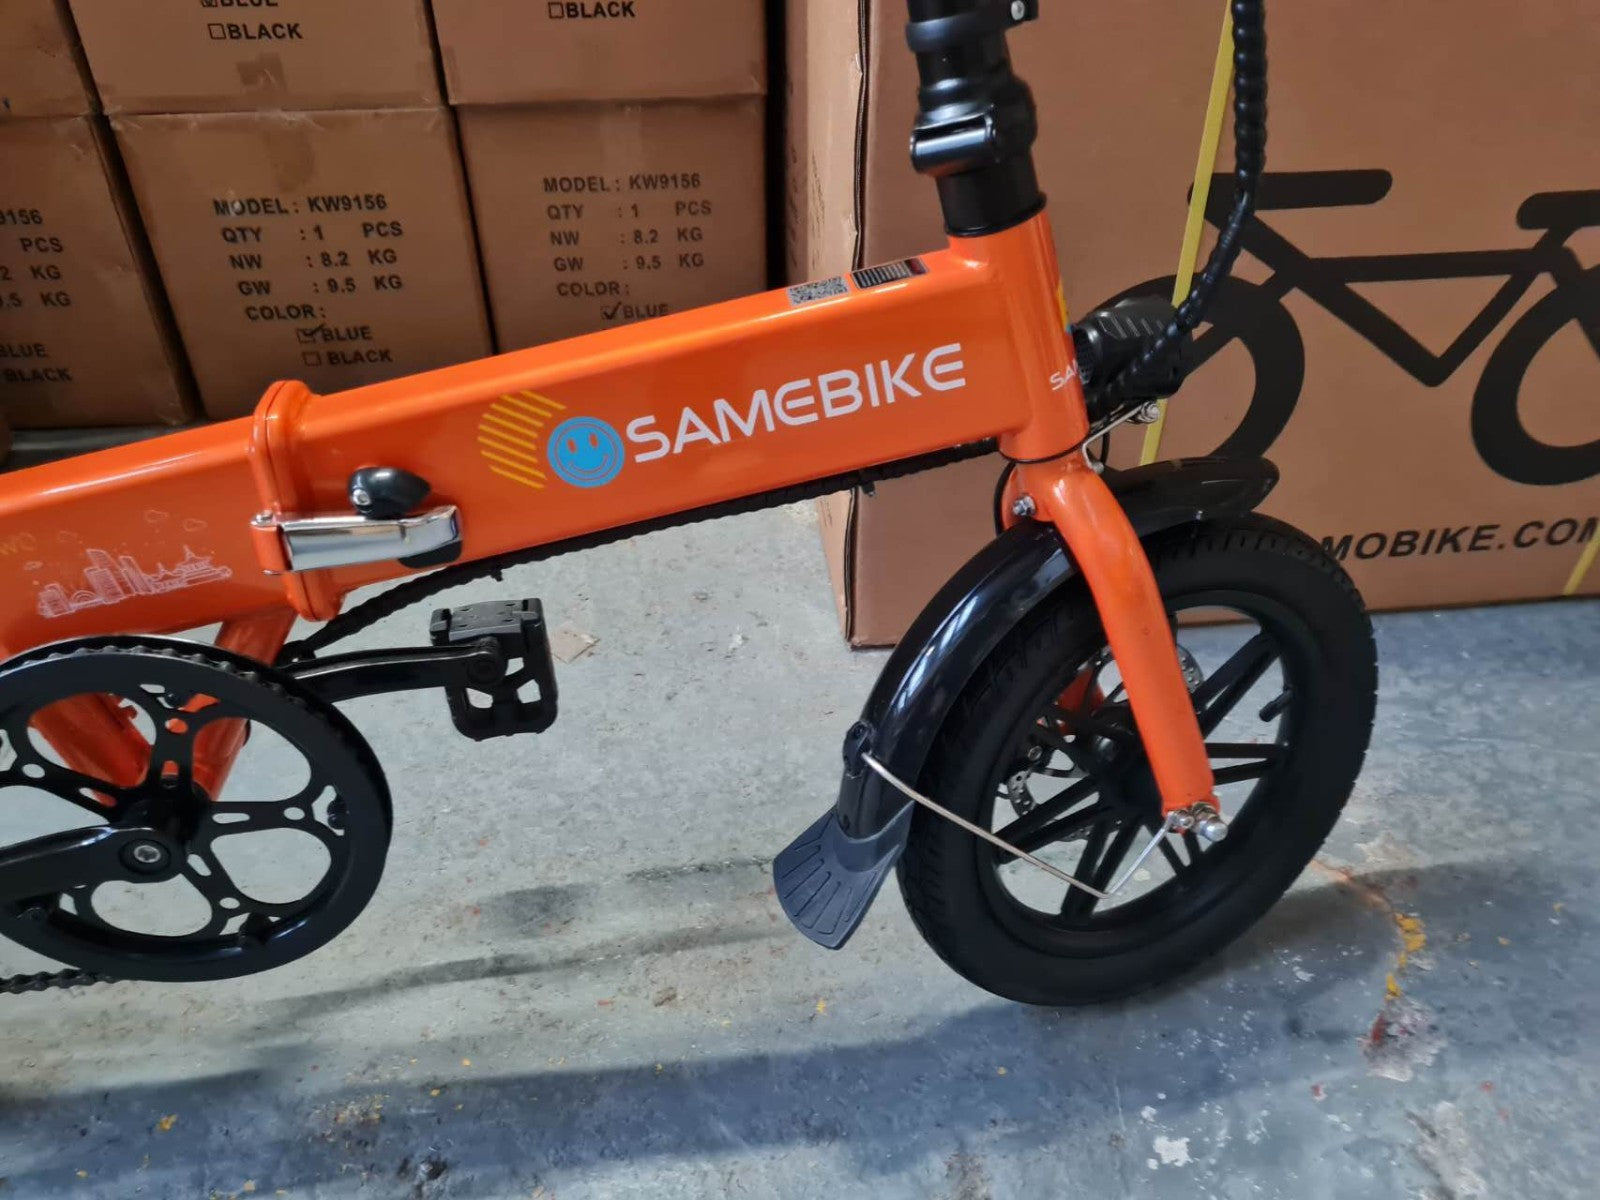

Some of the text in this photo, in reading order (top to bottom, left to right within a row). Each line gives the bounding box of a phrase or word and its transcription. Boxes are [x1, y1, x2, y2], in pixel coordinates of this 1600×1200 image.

[566, 1, 636, 18] BLACK
[227, 23, 303, 40] BLACK
[629, 172, 701, 190] KW9156
[307, 193, 388, 213] KW9156
[547, 203, 584, 220] QTY
[675, 199, 712, 217] PCS
[222, 226, 262, 244] QTY
[362, 220, 403, 238] PCS
[550, 230, 580, 246] NW
[633, 228, 659, 244] 8.2
[677, 226, 703, 242] KG
[20, 236, 63, 253] PCS
[229, 253, 263, 270] NW
[321, 250, 349, 267] 8.2
[368, 248, 397, 265] KG
[553, 256, 584, 272] GW
[636, 255, 662, 271] 9.5
[680, 252, 704, 269] KG
[30, 264, 61, 281] KG
[238, 280, 271, 296] GW
[327, 276, 356, 294] 9.5
[374, 274, 402, 291] KG
[0, 291, 71, 308] .5 KG
[623, 303, 669, 320] BLUE
[322, 325, 373, 343] BLUE
[327, 350, 393, 365] BLACK
[4, 367, 73, 382] BLACK
[625, 342, 966, 463] SAMEBIKE
